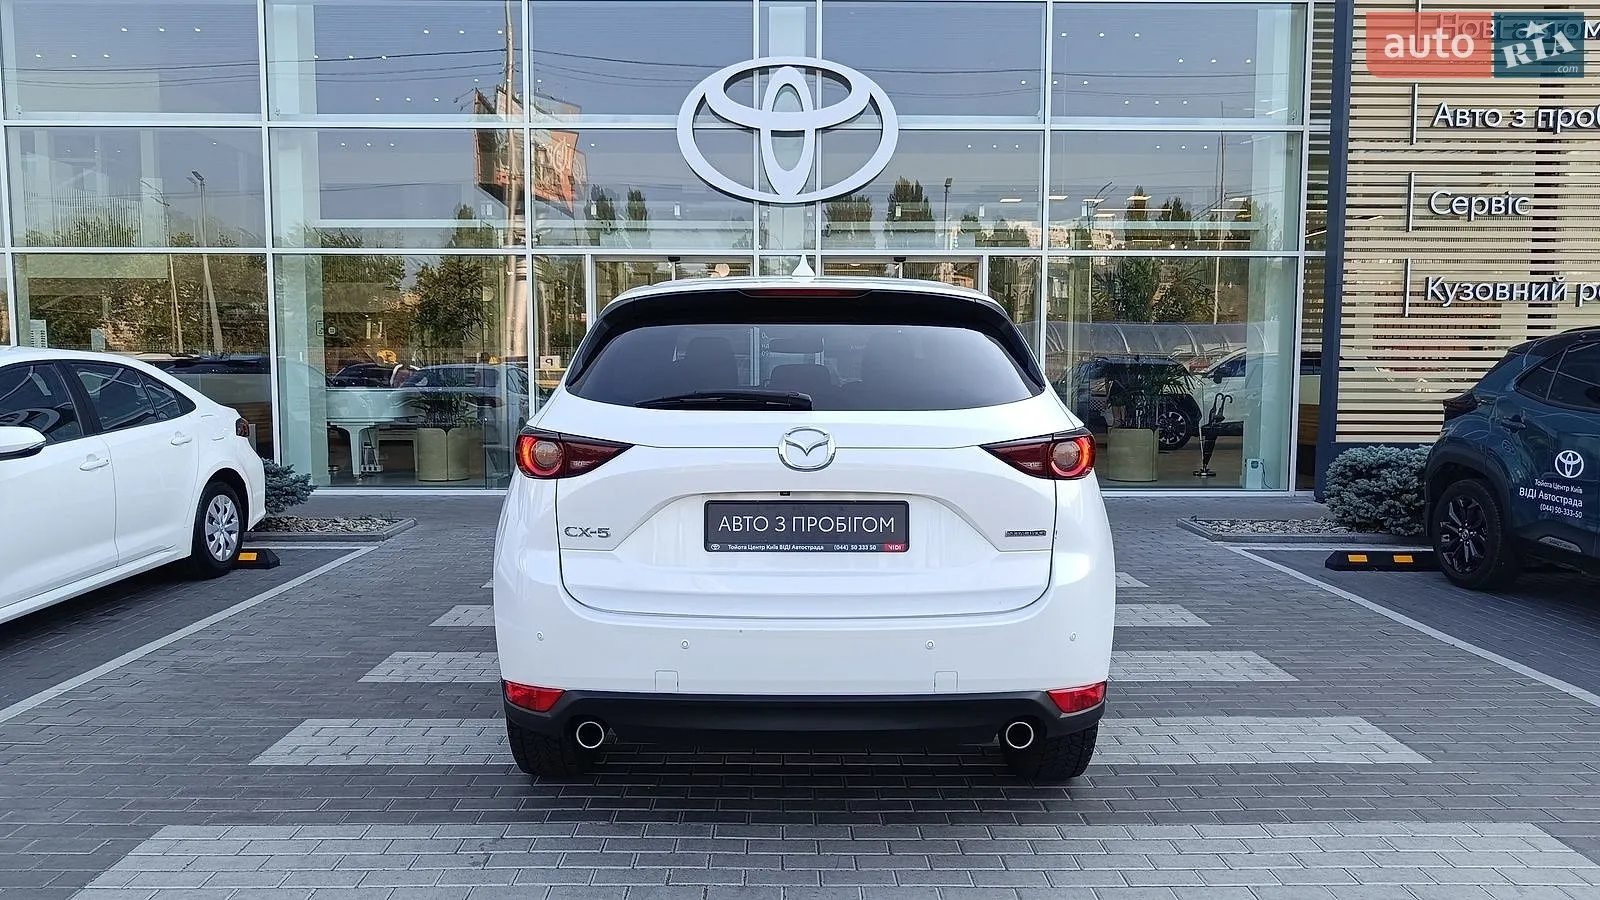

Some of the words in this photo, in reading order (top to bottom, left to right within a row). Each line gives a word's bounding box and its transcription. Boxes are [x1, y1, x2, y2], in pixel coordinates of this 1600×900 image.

[1431, 101, 1503, 128] Авто
[1511, 108, 1527, 128] з
[1537, 104, 1600, 134] про
[1430, 190, 1531, 222] Сервіс
[1426, 276, 1568, 308] Кузовний
[1579, 282, 1600, 308] р
[1519, 486, 1537, 500] ВІДІ
[1538, 489, 1583, 508] Автострада
[1552, 482, 1570, 493] Центр
[1539, 503, 1555, 513] (044)
[1554, 506, 1583, 519] 50-333-50
[563, 526, 612, 539] CX-5
[718, 515, 769, 533] АВТО
[774, 516, 786, 532] З
[792, 516, 895, 533] ПРОБІГОМ
